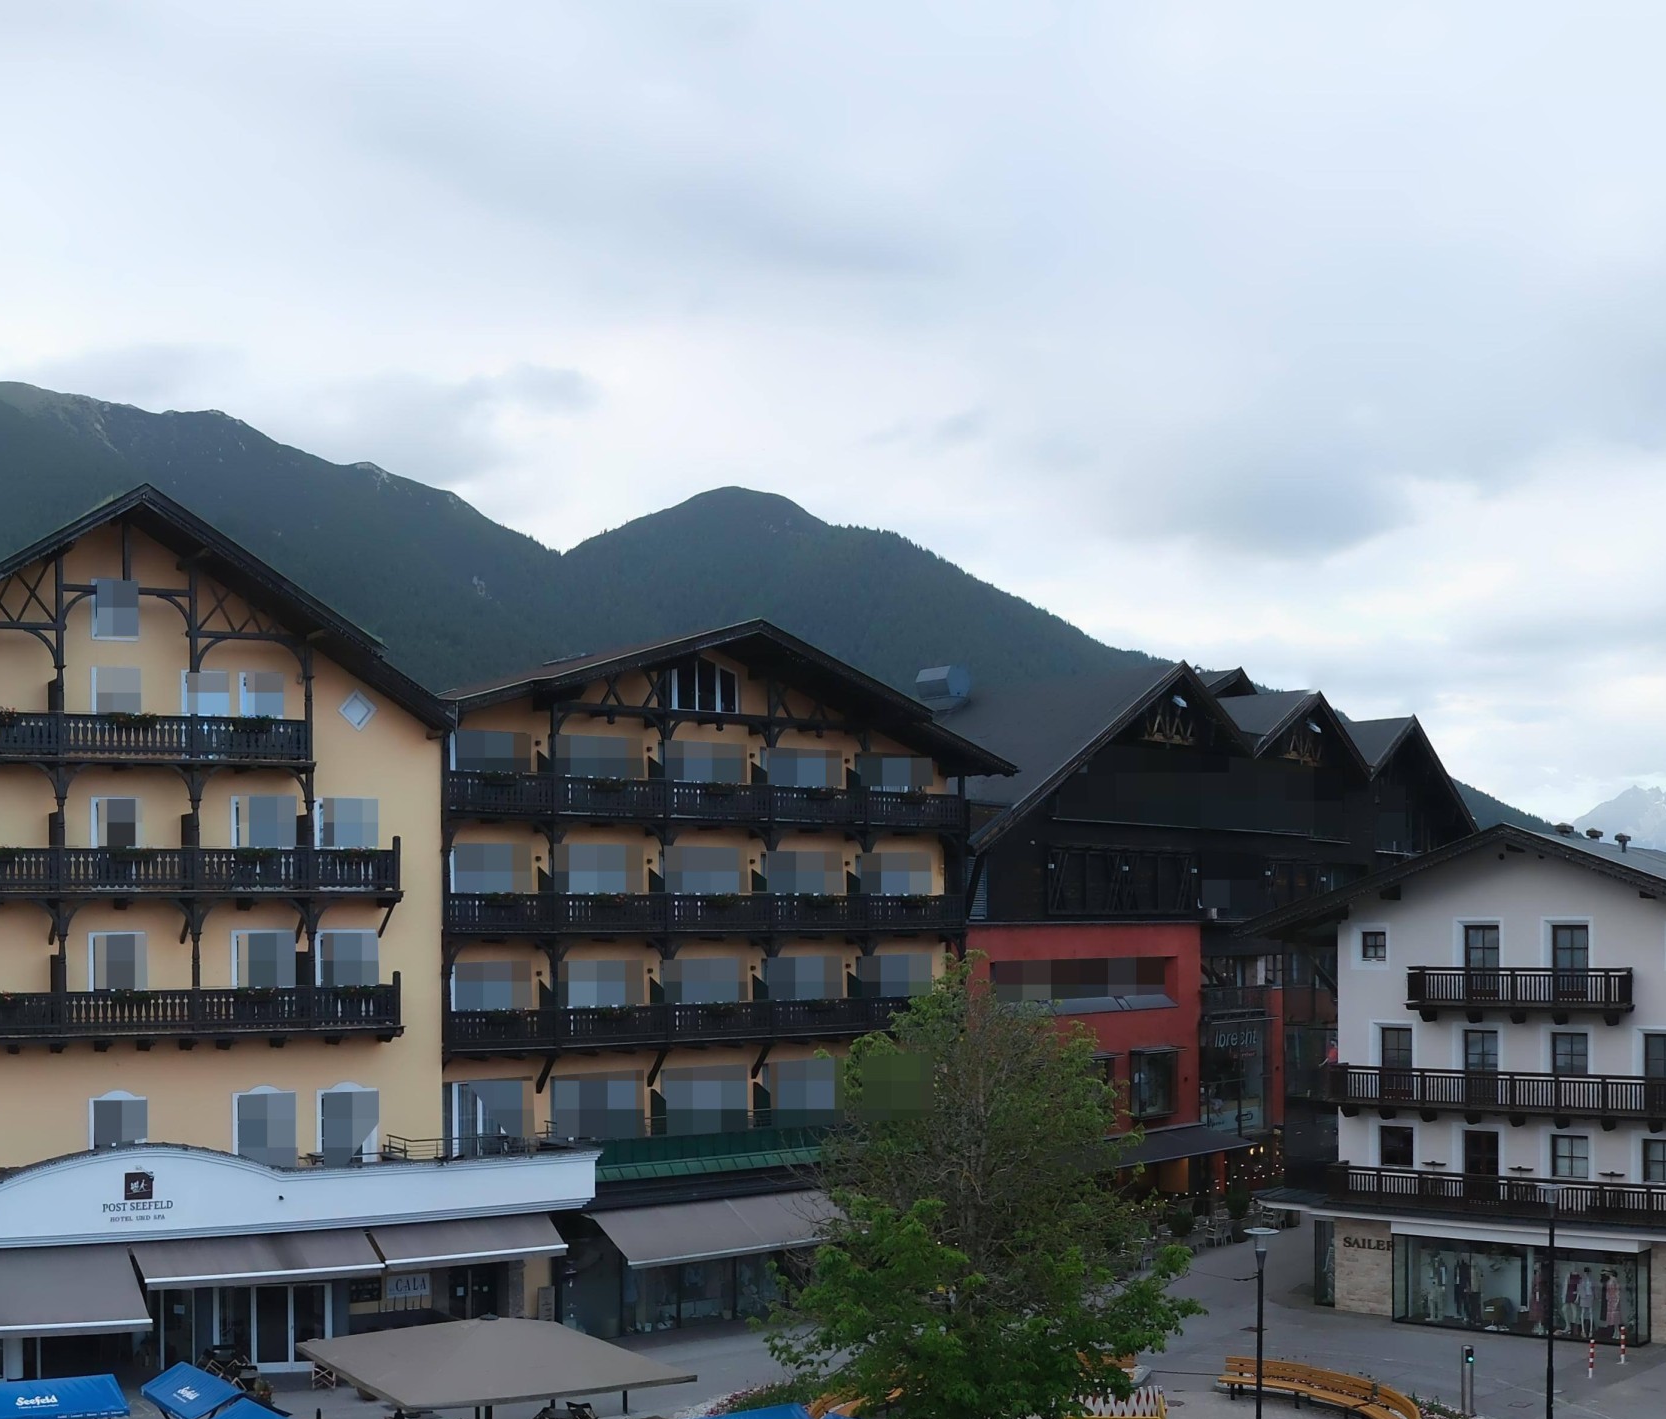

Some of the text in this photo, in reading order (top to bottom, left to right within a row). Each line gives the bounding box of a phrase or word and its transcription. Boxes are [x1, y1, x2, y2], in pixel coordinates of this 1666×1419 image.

[102, 1200, 173, 1213] POST SEEFELD
[15, 1395, 58, 1407] Seefeld
